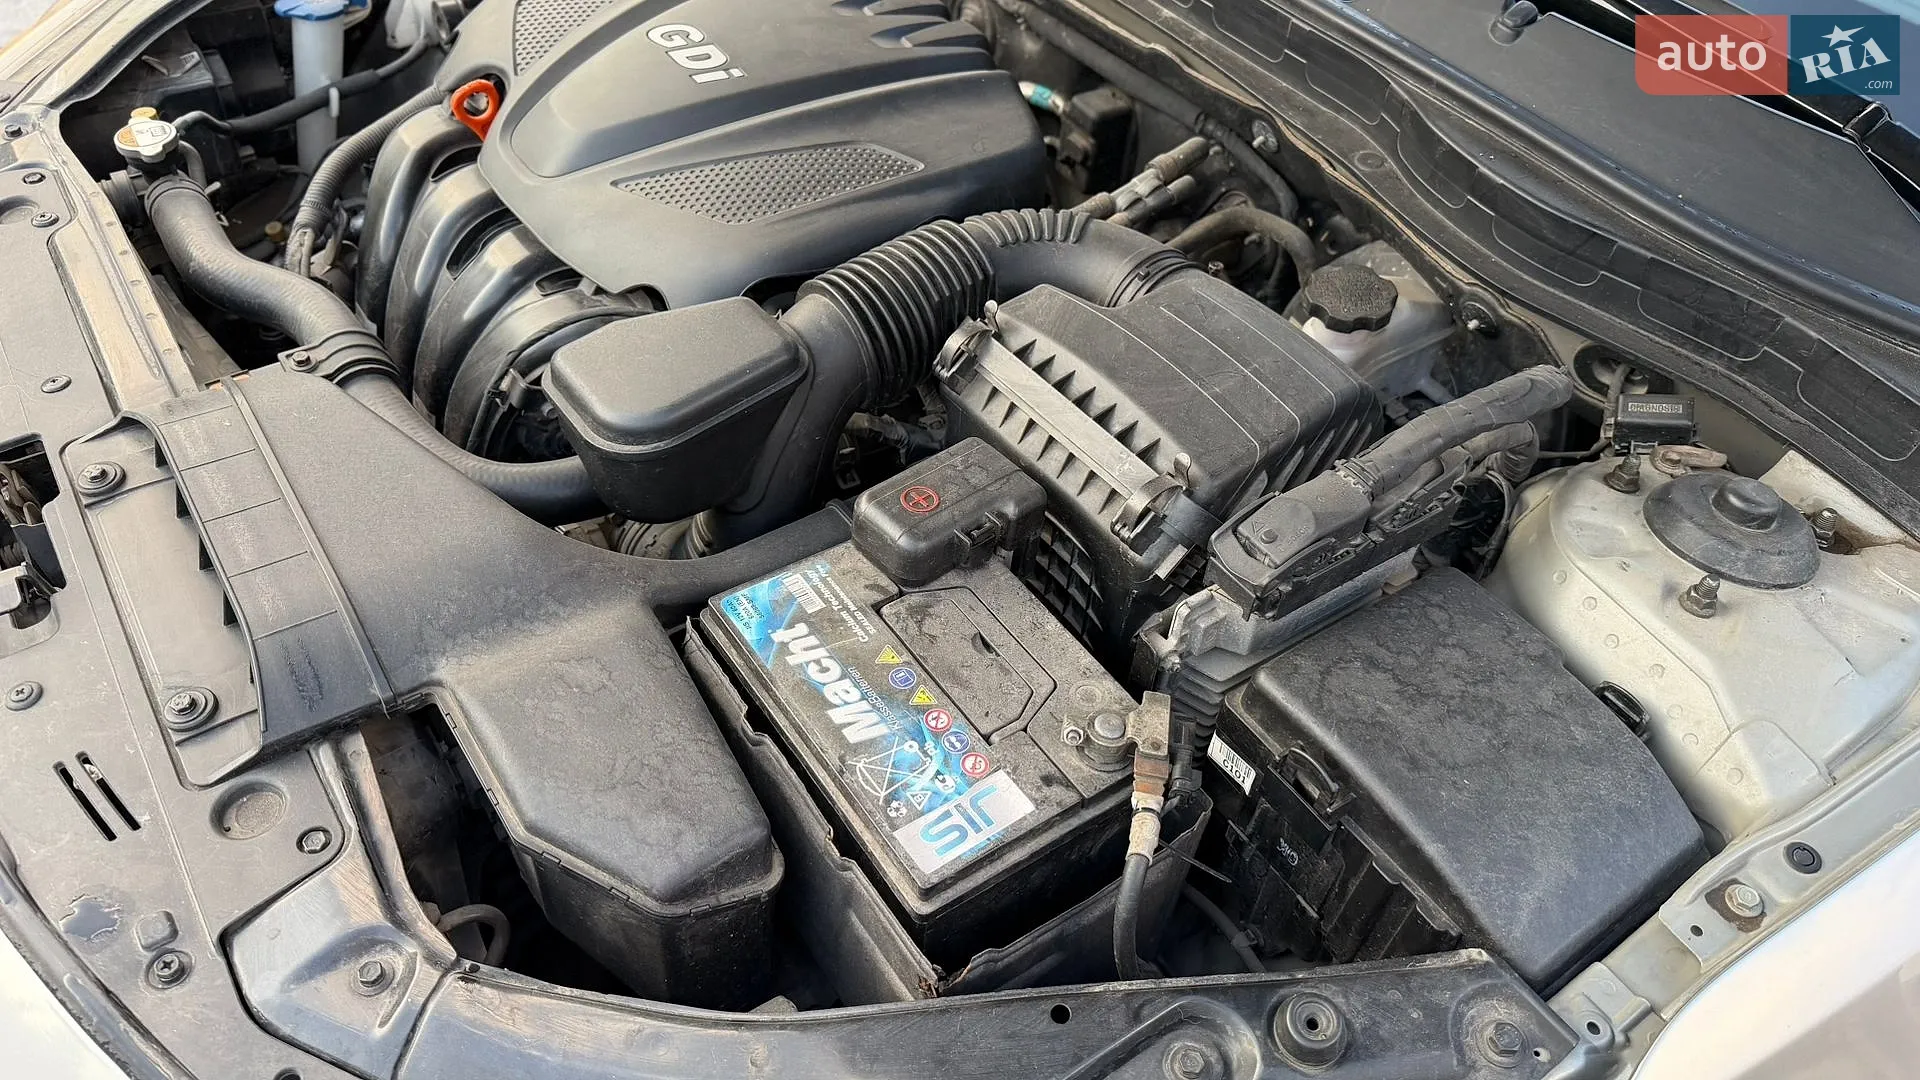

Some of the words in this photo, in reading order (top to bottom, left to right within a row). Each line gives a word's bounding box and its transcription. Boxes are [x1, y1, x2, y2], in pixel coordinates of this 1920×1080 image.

[646, 23, 745, 85] GDi
[1629, 403, 1682, 413] DIAGNOSIS
[804, 568, 842, 611] Technology
[826, 576, 858, 612] Maintenance
[840, 610, 869, 643] Calcium
[855, 611, 877, 636] SEALED
[769, 622, 891, 744] Macht
[1222, 758, 1247, 784] C101
[919, 783, 1000, 858] JIS
